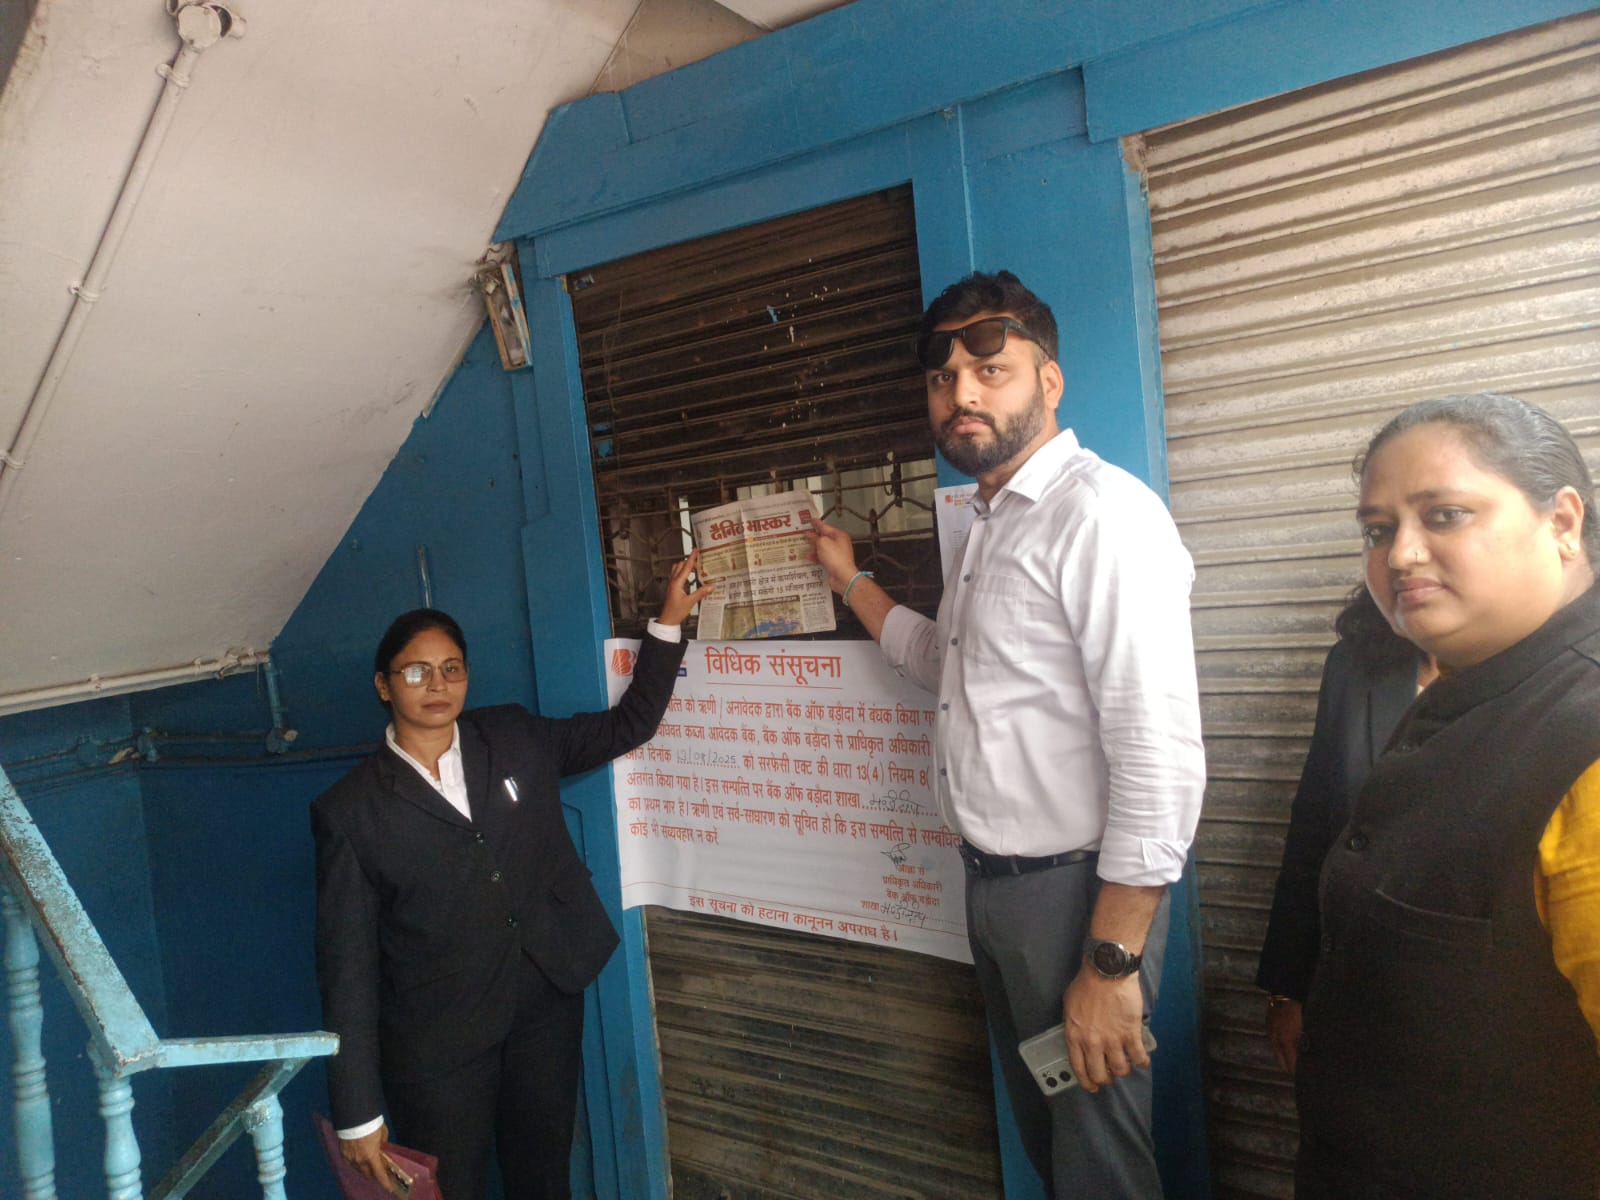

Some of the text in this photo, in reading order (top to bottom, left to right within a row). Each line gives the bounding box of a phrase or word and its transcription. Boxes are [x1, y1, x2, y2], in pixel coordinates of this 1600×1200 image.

[745, 515, 791, 533] भास्कर
[704, 646, 761, 675] विधिक
[766, 648, 842, 685] संसूचना
[685, 695, 696, 714] को
[697, 694, 717, 714] ऋणी
[726, 696, 762, 717] अनावेदक
[764, 701, 784, 719] द्वारा
[785, 698, 802, 720] बैंक
[804, 700, 825, 721] ऑफ
[827, 700, 855, 725] बड़ौदा
[857, 701, 866, 723] में
[868, 703, 892, 724] बंधक
[895, 703, 920, 726] किया
[684, 725, 705, 739] कब्जा
[708, 722, 738, 742] आवेदक
[761, 724, 778, 745] बैंक
[781, 727, 801, 746] ऑफ
[803, 727, 831, 751] बड़ौदा
[833, 729, 844, 750] से
[846, 729, 884, 758] प्राधिकृत
[888, 732, 931, 757] अधिकारी
[647, 742, 672, 762] दिनांक
[742, 749, 755, 770] को
[757, 752, 790, 774] सरफेसी
[794, 759, 813, 774] एक्ट
[816, 755, 829, 776] की
[832, 761, 852, 779] धारा
[887, 761, 915, 785] नियम
[626, 766, 654, 786] अंतर्गत
[655, 769, 674, 789] किया
[676, 775, 691, 790] गया
[704, 777, 719, 794] इस
[721, 776, 750, 796] सम्पत्ति
[751, 782, 764, 797] पर
[766, 778, 782, 800] बैंक
[784, 782, 804, 802] ऑफ
[806, 784, 832, 807] बड़ौदा
[834, 790, 861, 809] शाखा
[627, 797, 641, 811] का
[643, 797, 660, 813] प्रथम
[662, 800, 676, 816] भार
[691, 797, 710, 819] ऋणी
[712, 802, 724, 820] एवं
[777, 807, 790, 828] को
[792, 809, 819, 835] सूचित
[821, 811, 832, 833] हो
[834, 813, 847, 835] कि
[849, 820, 867, 839] इस
[869, 819, 904, 842] सम्पत्ति
[907, 822, 918, 844] से
[629, 817, 649, 838] कोई
[696, 829, 704, 844] न
[705, 826, 720, 846] करें
[688, 894, 705, 908] इस
[708, 897, 737, 914] सूचना
[740, 901, 754, 916] को
[758, 907, 789, 923] हटाना
[793, 913, 833, 931] कानूनन
[837, 920, 877, 938] अपराध
